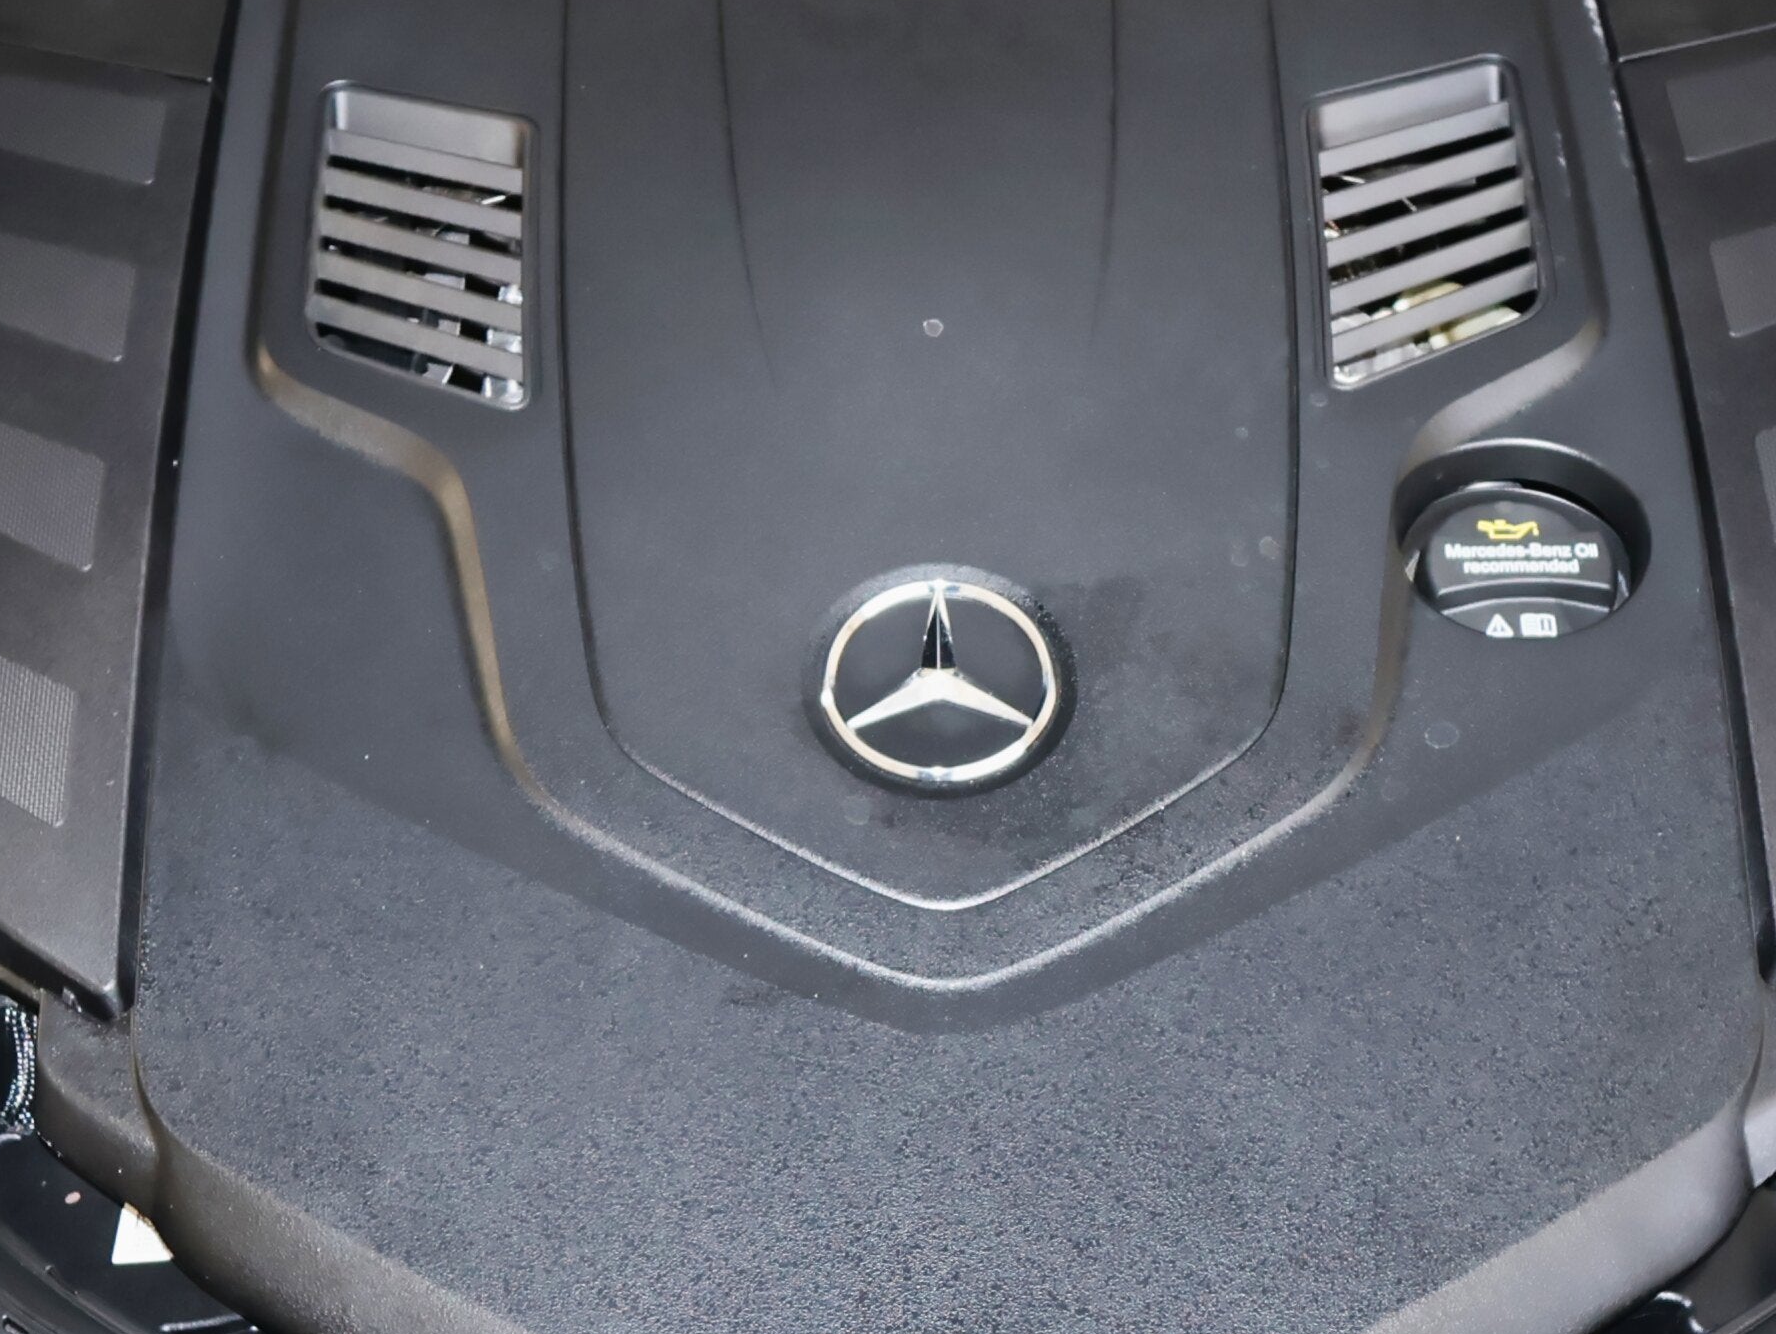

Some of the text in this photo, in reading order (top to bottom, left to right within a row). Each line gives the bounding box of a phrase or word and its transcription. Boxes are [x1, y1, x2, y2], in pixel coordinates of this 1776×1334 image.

[1444, 542, 1599, 559] Mercedes-Benz Oil
[1463, 558, 1580, 574] recommended
